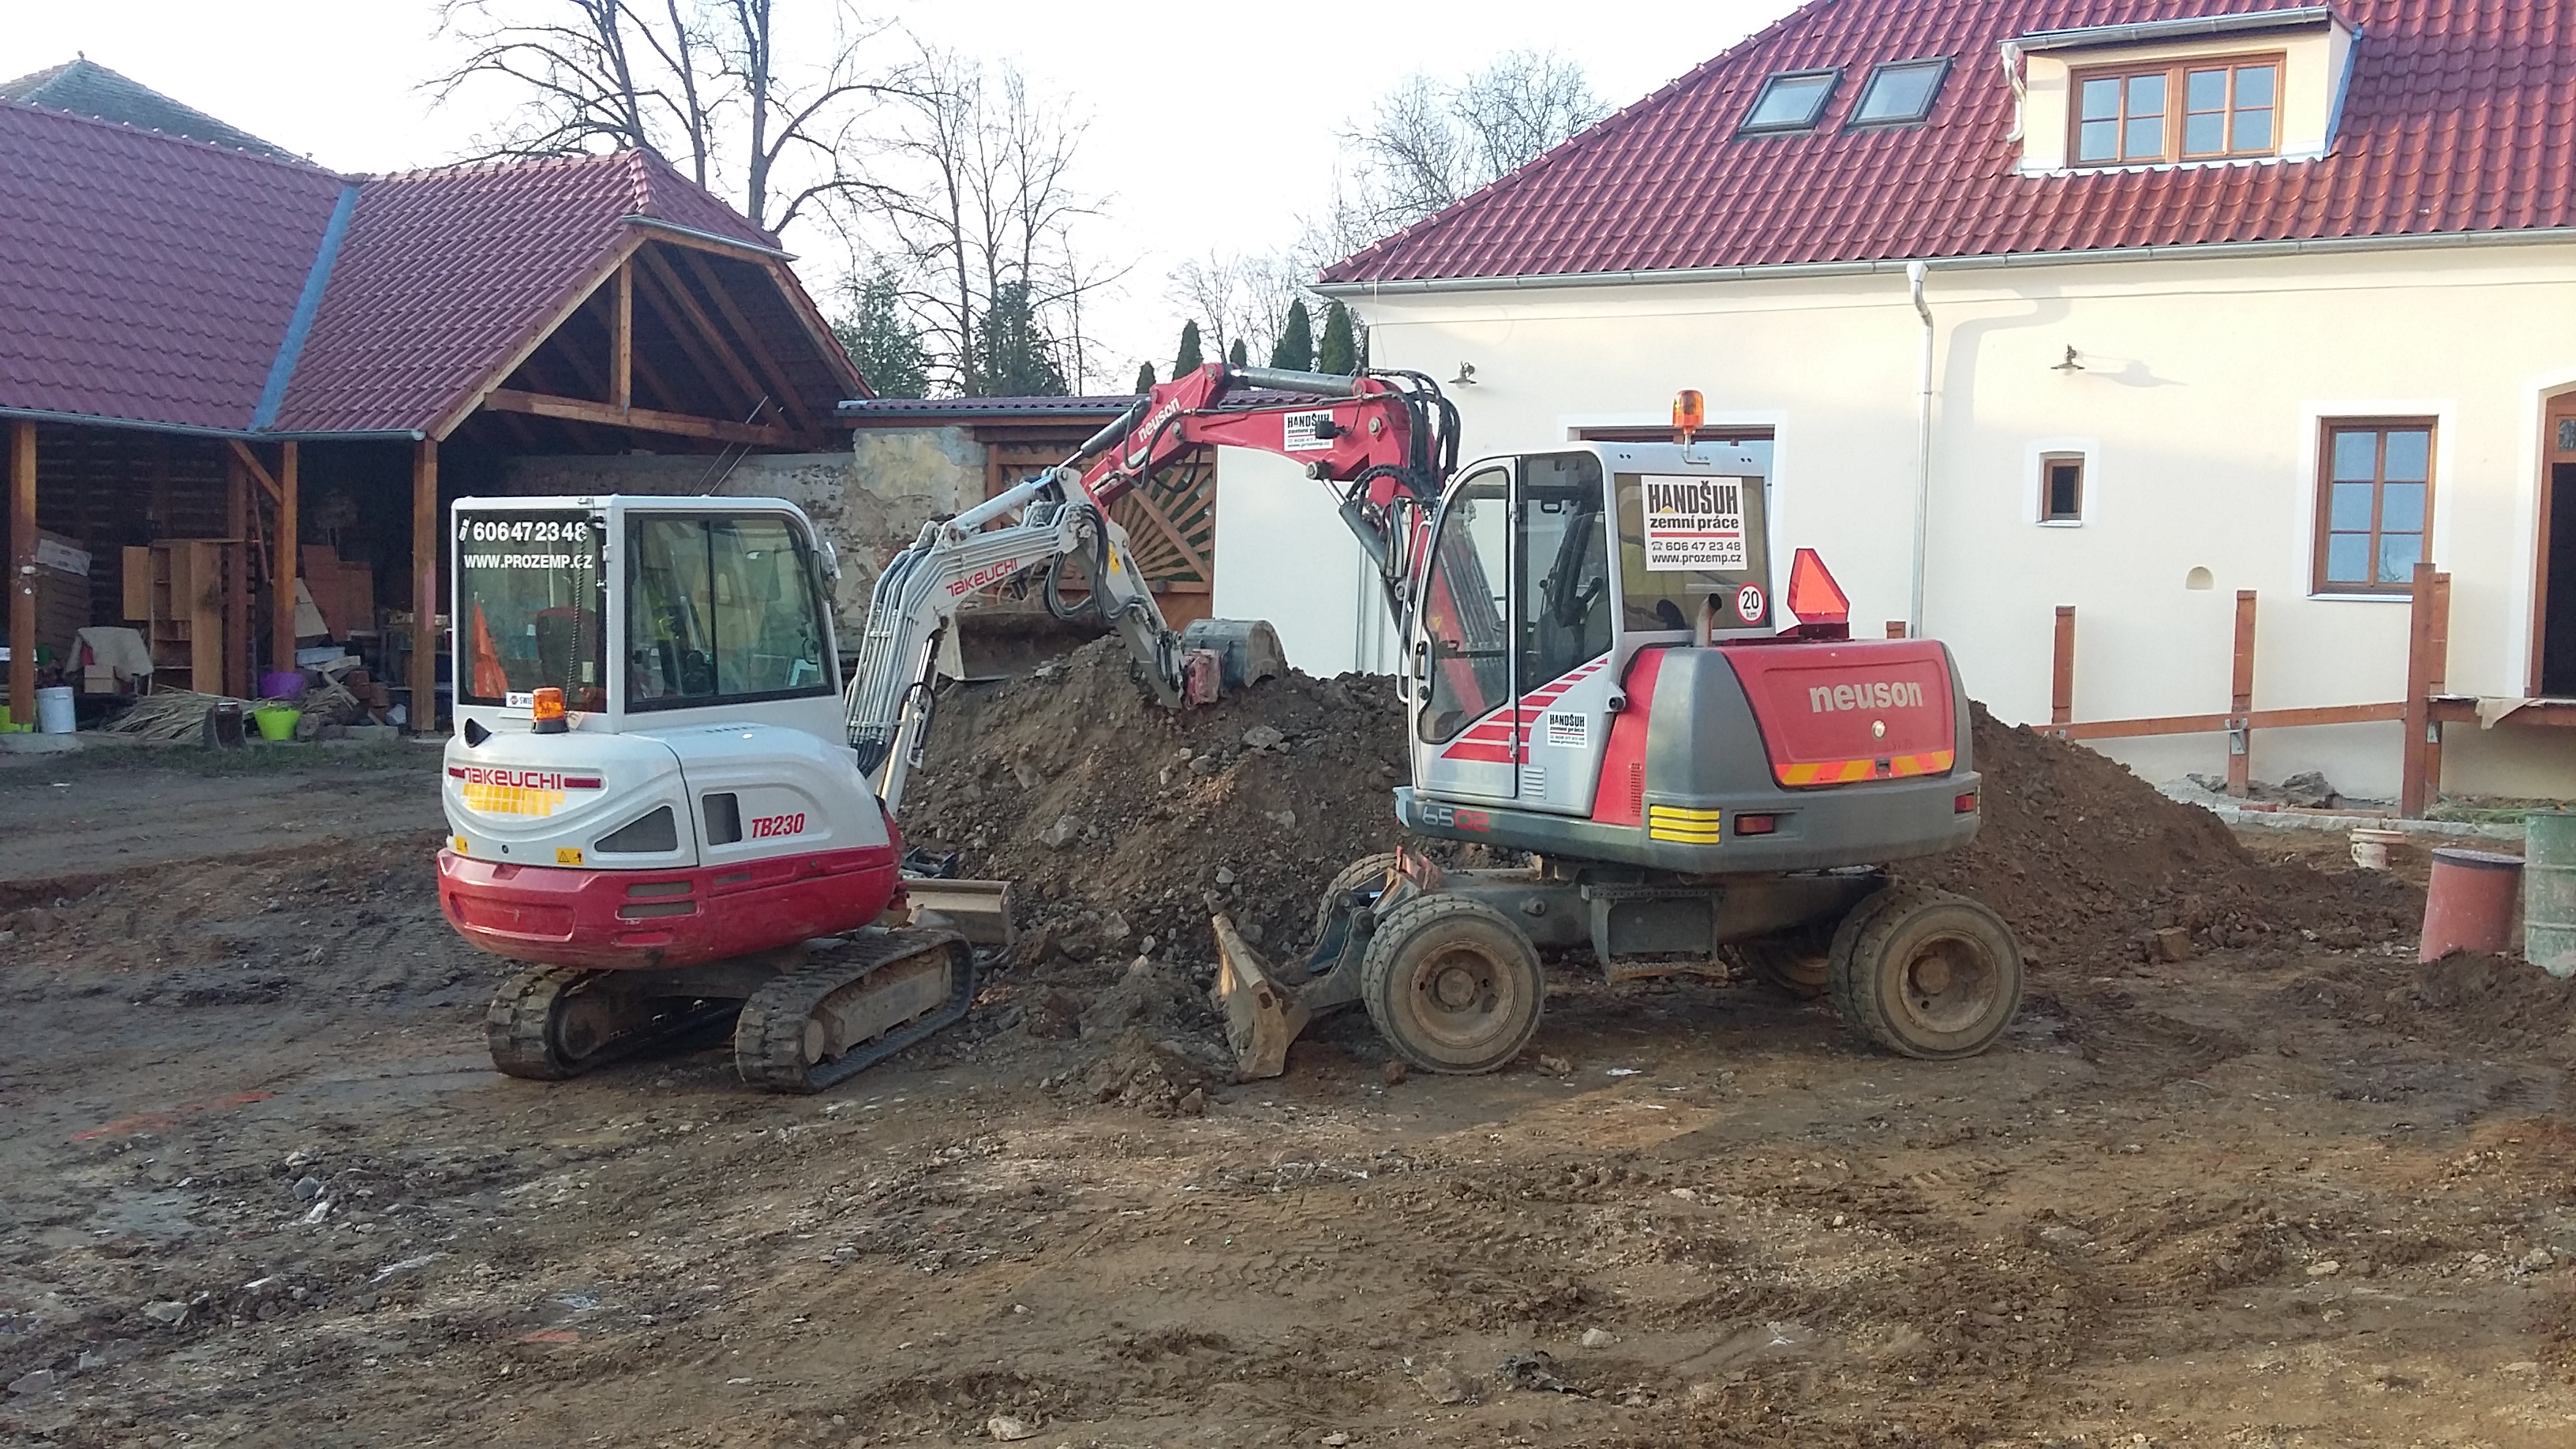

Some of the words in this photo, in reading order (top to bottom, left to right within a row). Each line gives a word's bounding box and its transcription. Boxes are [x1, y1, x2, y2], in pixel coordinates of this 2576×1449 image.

[1138, 397, 1181, 443] neuson
[1647, 481, 1739, 515] HANDŠUH
[1649, 515, 1695, 529] zemní
[1698, 515, 1739, 532] práce
[1665, 541, 1689, 552] 606
[1691, 541, 1706, 552] 47
[1709, 541, 1724, 552] 23
[1726, 541, 1741, 552] 48
[464, 554, 593, 569] WWW.PROZEMP.CZ
[1652, 553, 1742, 565] www.prozemp.cz
[1742, 590, 1759, 609] 20
[1809, 681, 1923, 713] neuson
[1549, 713, 1585, 727] HANDŠUH
[751, 813, 805, 839] TB230
[1422, 806, 1491, 833] 6502
